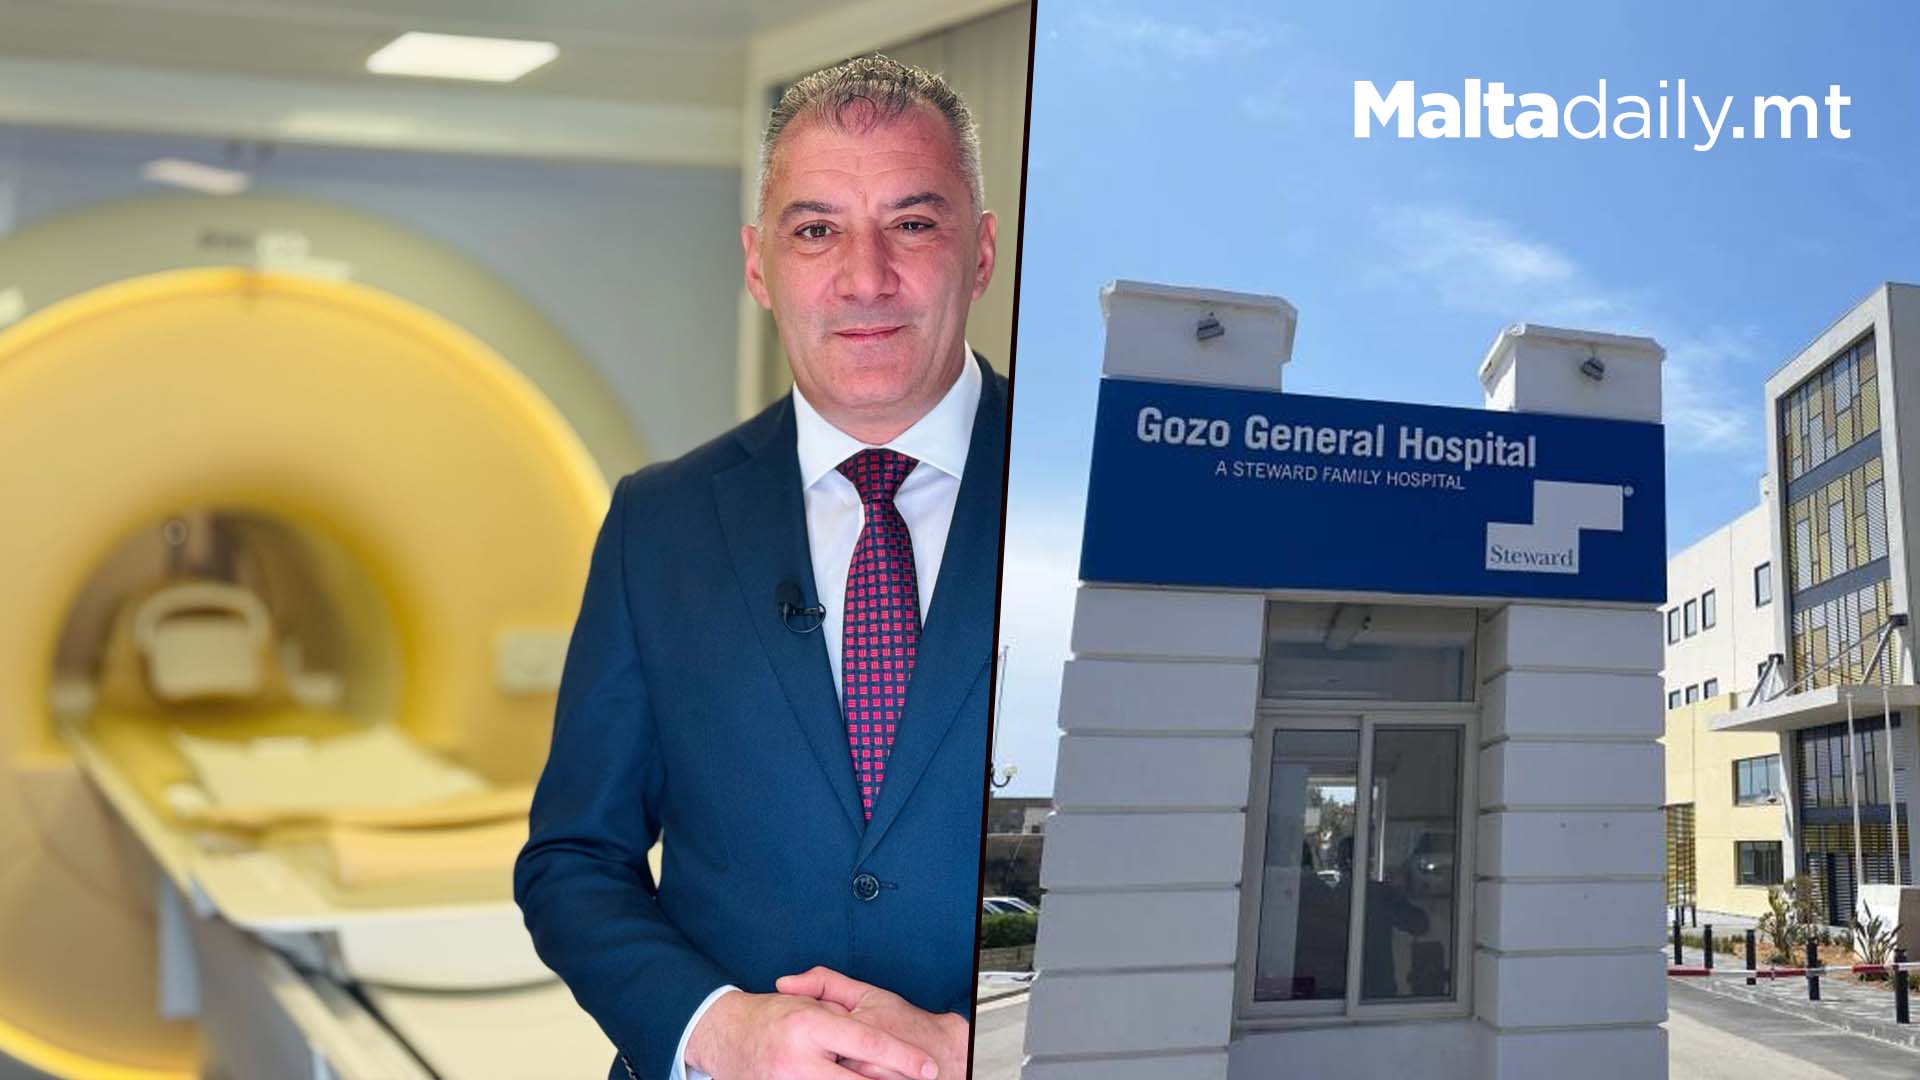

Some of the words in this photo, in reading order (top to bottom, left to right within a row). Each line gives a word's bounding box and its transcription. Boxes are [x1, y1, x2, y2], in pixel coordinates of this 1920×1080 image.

[1137, 406, 1231, 448] Gozo
[1244, 414, 1385, 458] General
[1399, 425, 1537, 471] Hospital
[1215, 461, 1228, 477] A
[1233, 462, 1318, 482] STEWARD
[1322, 466, 1382, 487] FAMILY
[1386, 470, 1466, 491] HOSPITAL
[1490, 543, 1575, 568] Steward
